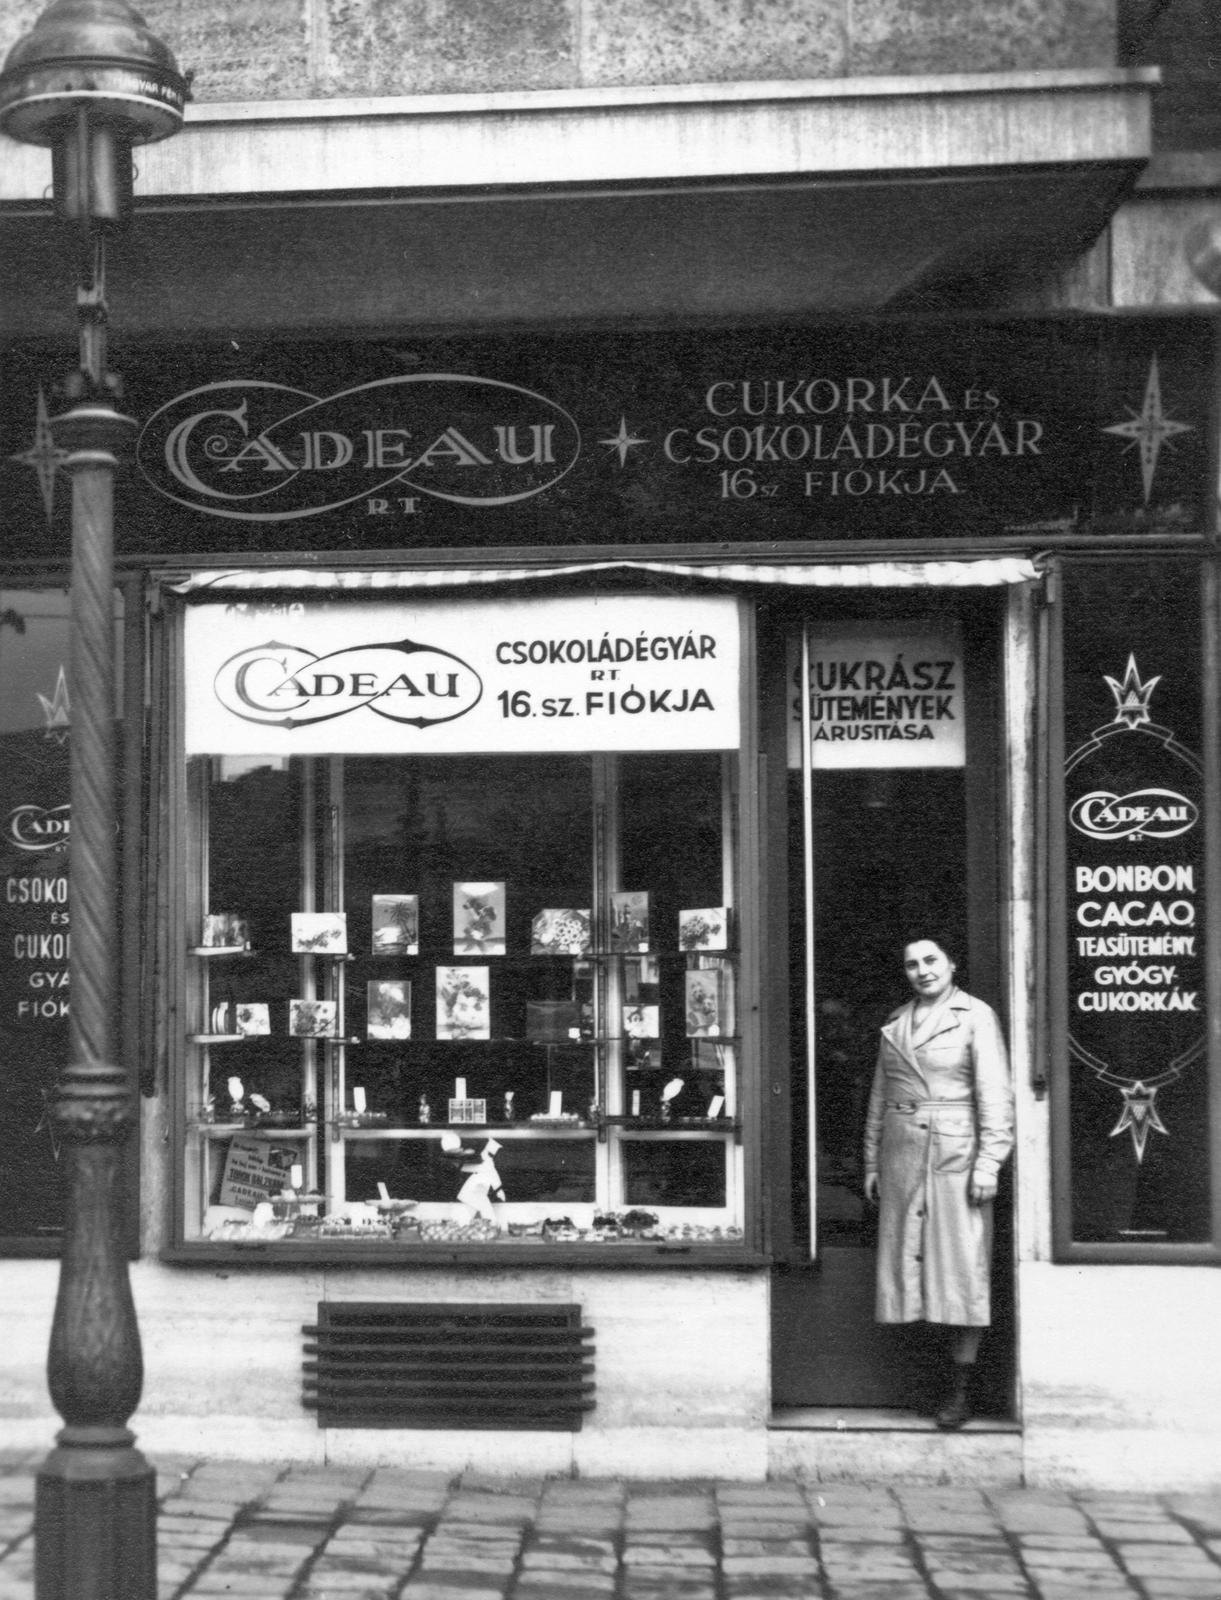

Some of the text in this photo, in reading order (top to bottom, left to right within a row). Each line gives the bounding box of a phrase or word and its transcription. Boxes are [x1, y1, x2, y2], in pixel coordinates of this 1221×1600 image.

[705, 375, 951, 417] CUKORKA
[164, 397, 556, 499] CADEAU
[663, 411, 1044, 463] CSOKOLÁDÉGYÁR
[718, 467, 758, 499] 16
[495, 630, 717, 665] CSOKOLÁDÉGYÁR
[234, 656, 460, 713] CADEAU
[586, 683, 715, 716] FIÓKJA
[1079, 798, 1189, 831] CADEAU
[1076, 865, 1197, 894] BONBON,
[1076, 900, 1196, 928] CACAO,
[1094, 960, 1179, 985] GYÓGY-
